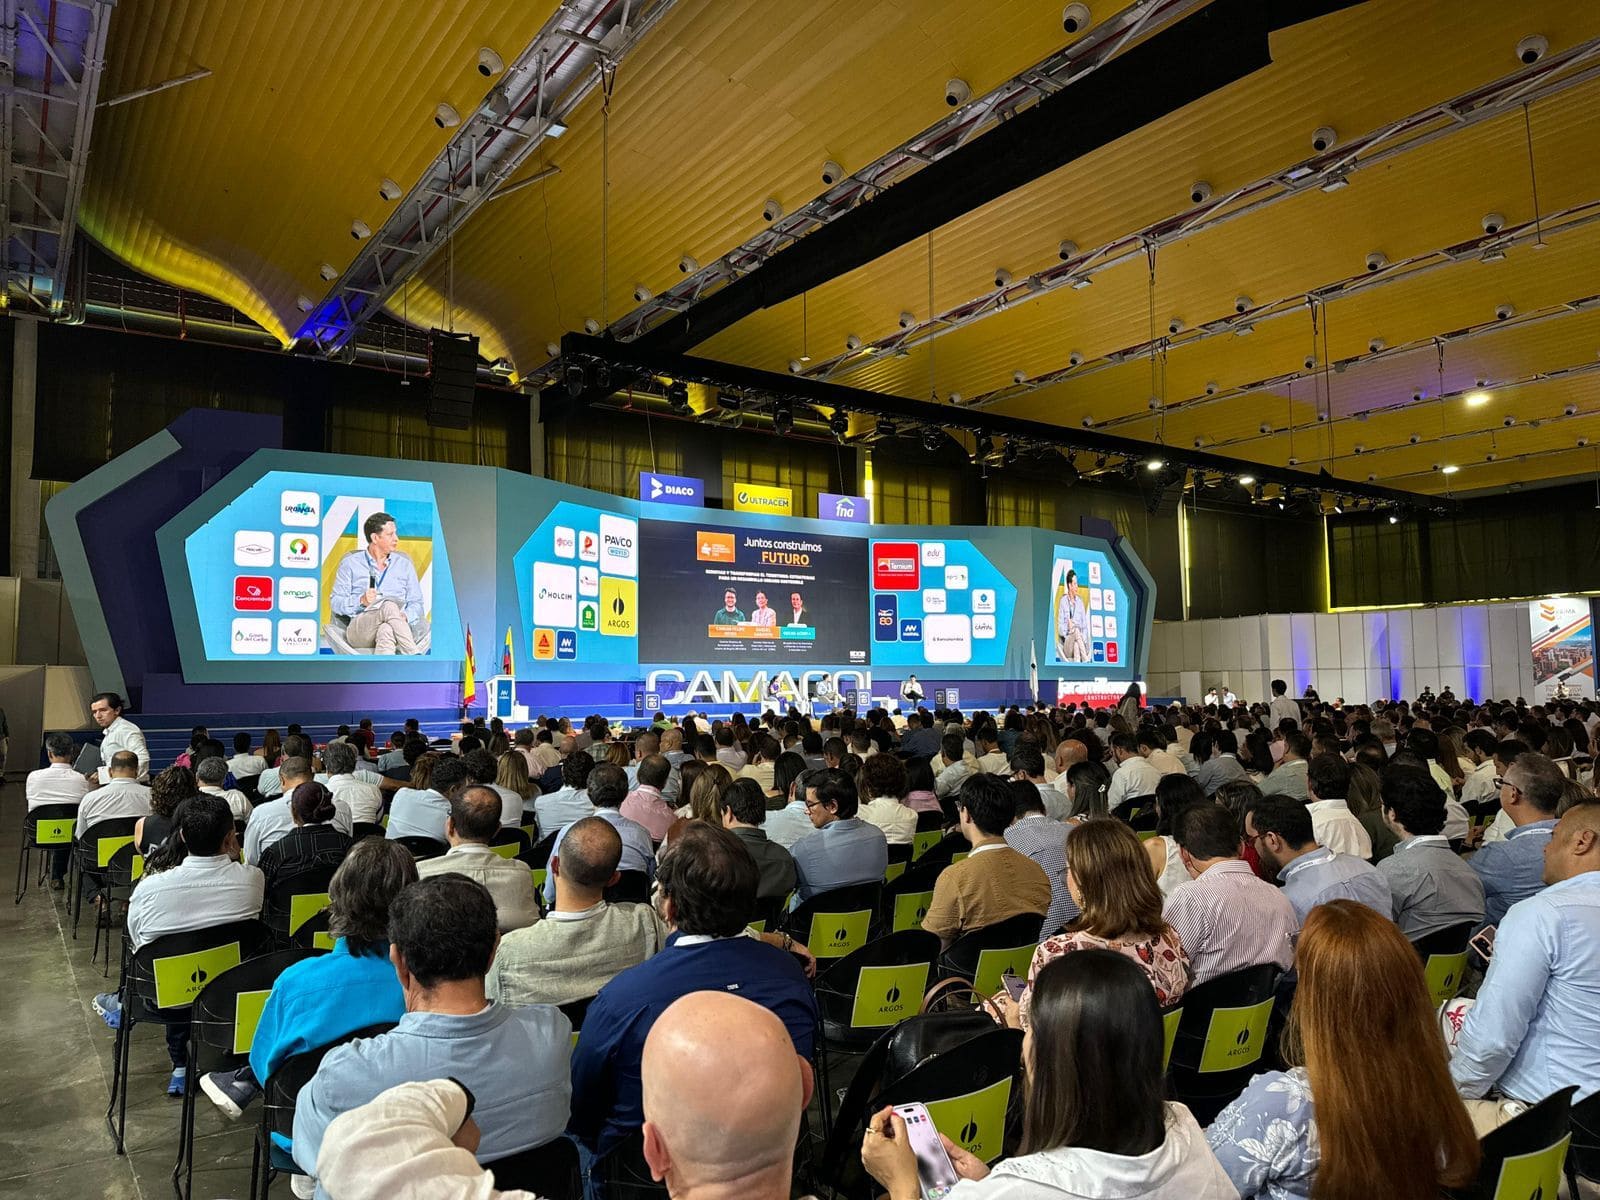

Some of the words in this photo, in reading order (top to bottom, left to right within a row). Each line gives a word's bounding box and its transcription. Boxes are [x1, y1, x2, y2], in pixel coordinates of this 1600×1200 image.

[665, 485, 694, 496] DIACO
[750, 496, 789, 507] ULTRACEM
[836, 503, 854, 518] fna
[604, 535, 632, 548] PAVCO
[744, 537, 773, 549] Juntos
[774, 541, 822, 552] construimos
[761, 551, 810, 565] FUTURO
[547, 592, 573, 601] HOLCIM
[607, 620, 630, 629] ARGOS
[185, 984, 204, 993] ARG
[878, 1004, 904, 1013] ARGOS
[1227, 1045, 1250, 1057] ARGOS
